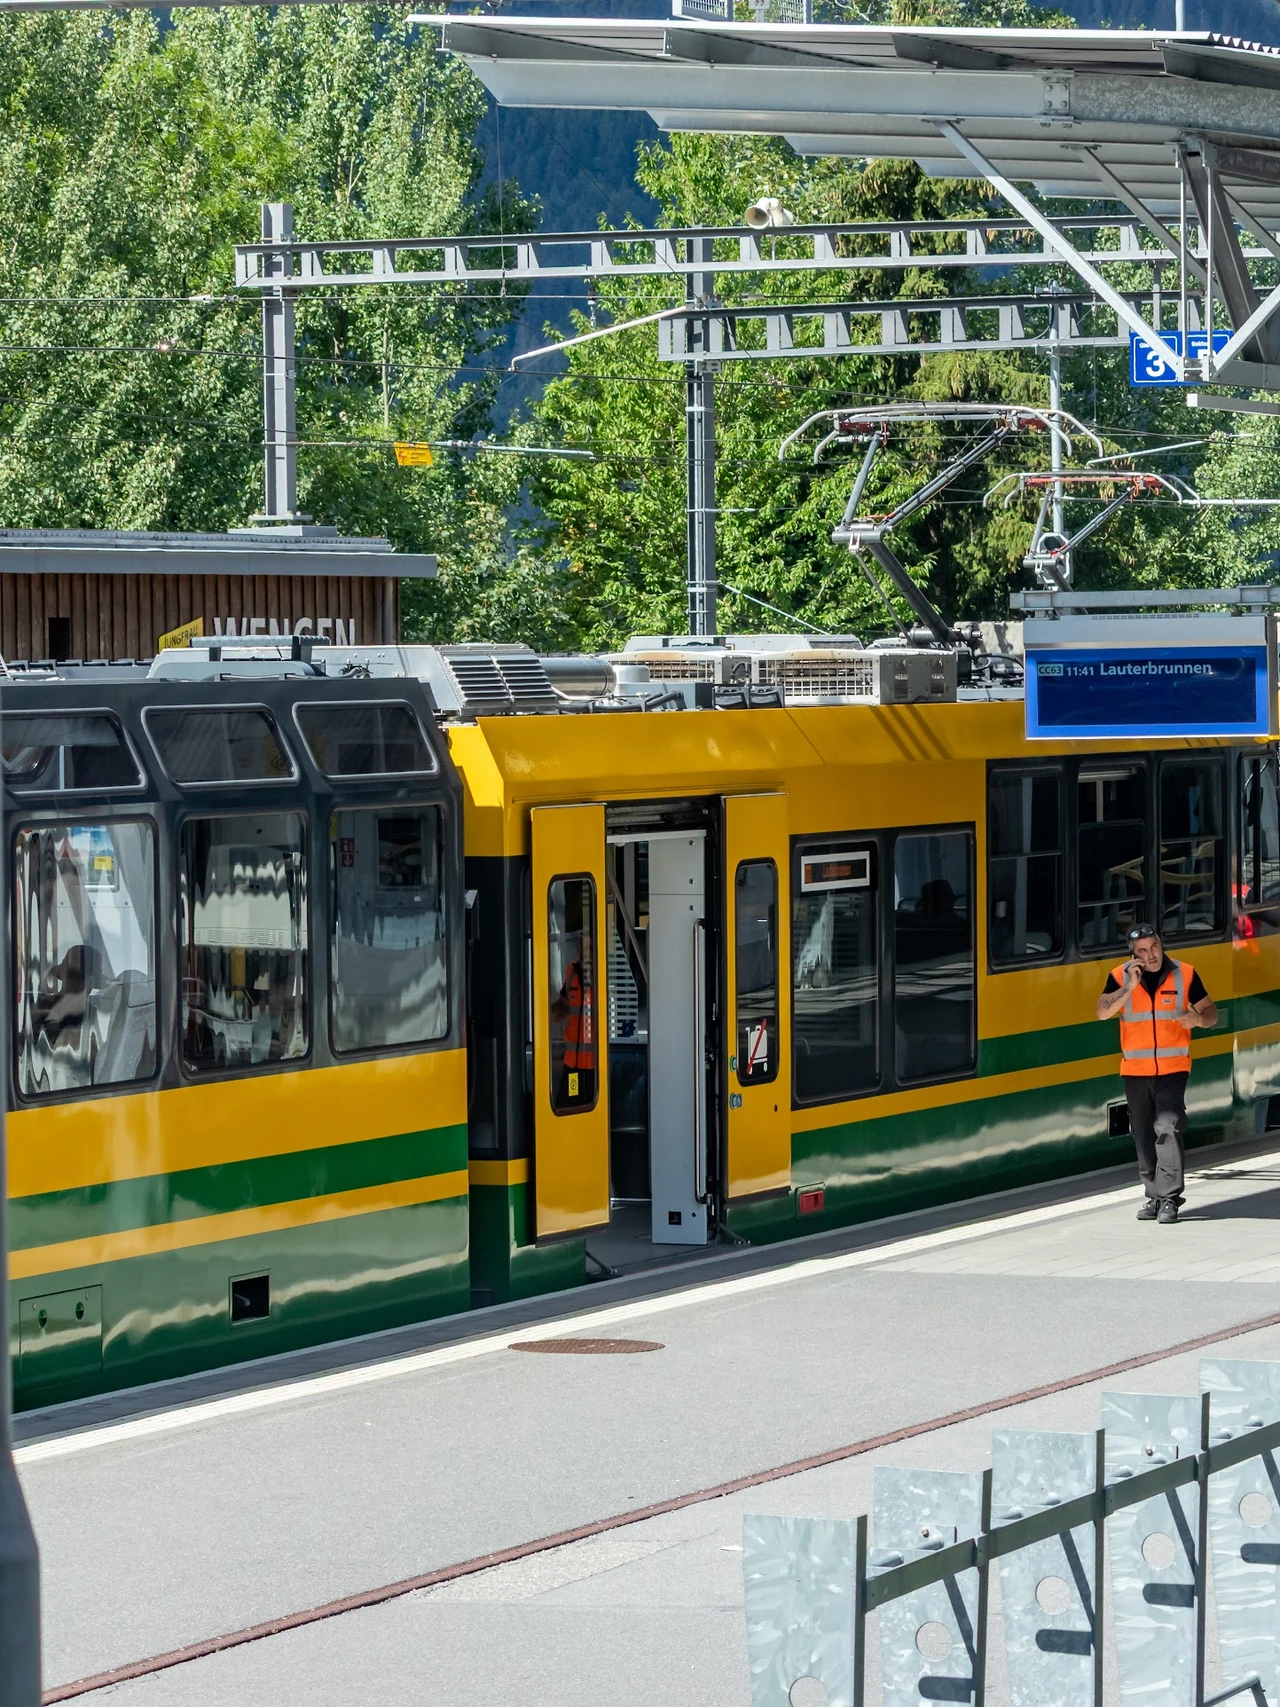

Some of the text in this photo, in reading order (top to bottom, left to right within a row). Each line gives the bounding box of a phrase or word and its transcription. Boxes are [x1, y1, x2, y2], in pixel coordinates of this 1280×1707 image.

[1145, 350, 1166, 377] 3
[164, 625, 198, 648] JUNGFRAU
[1038, 661, 1213, 676] CC63 11:41 Lauterbrunnen
